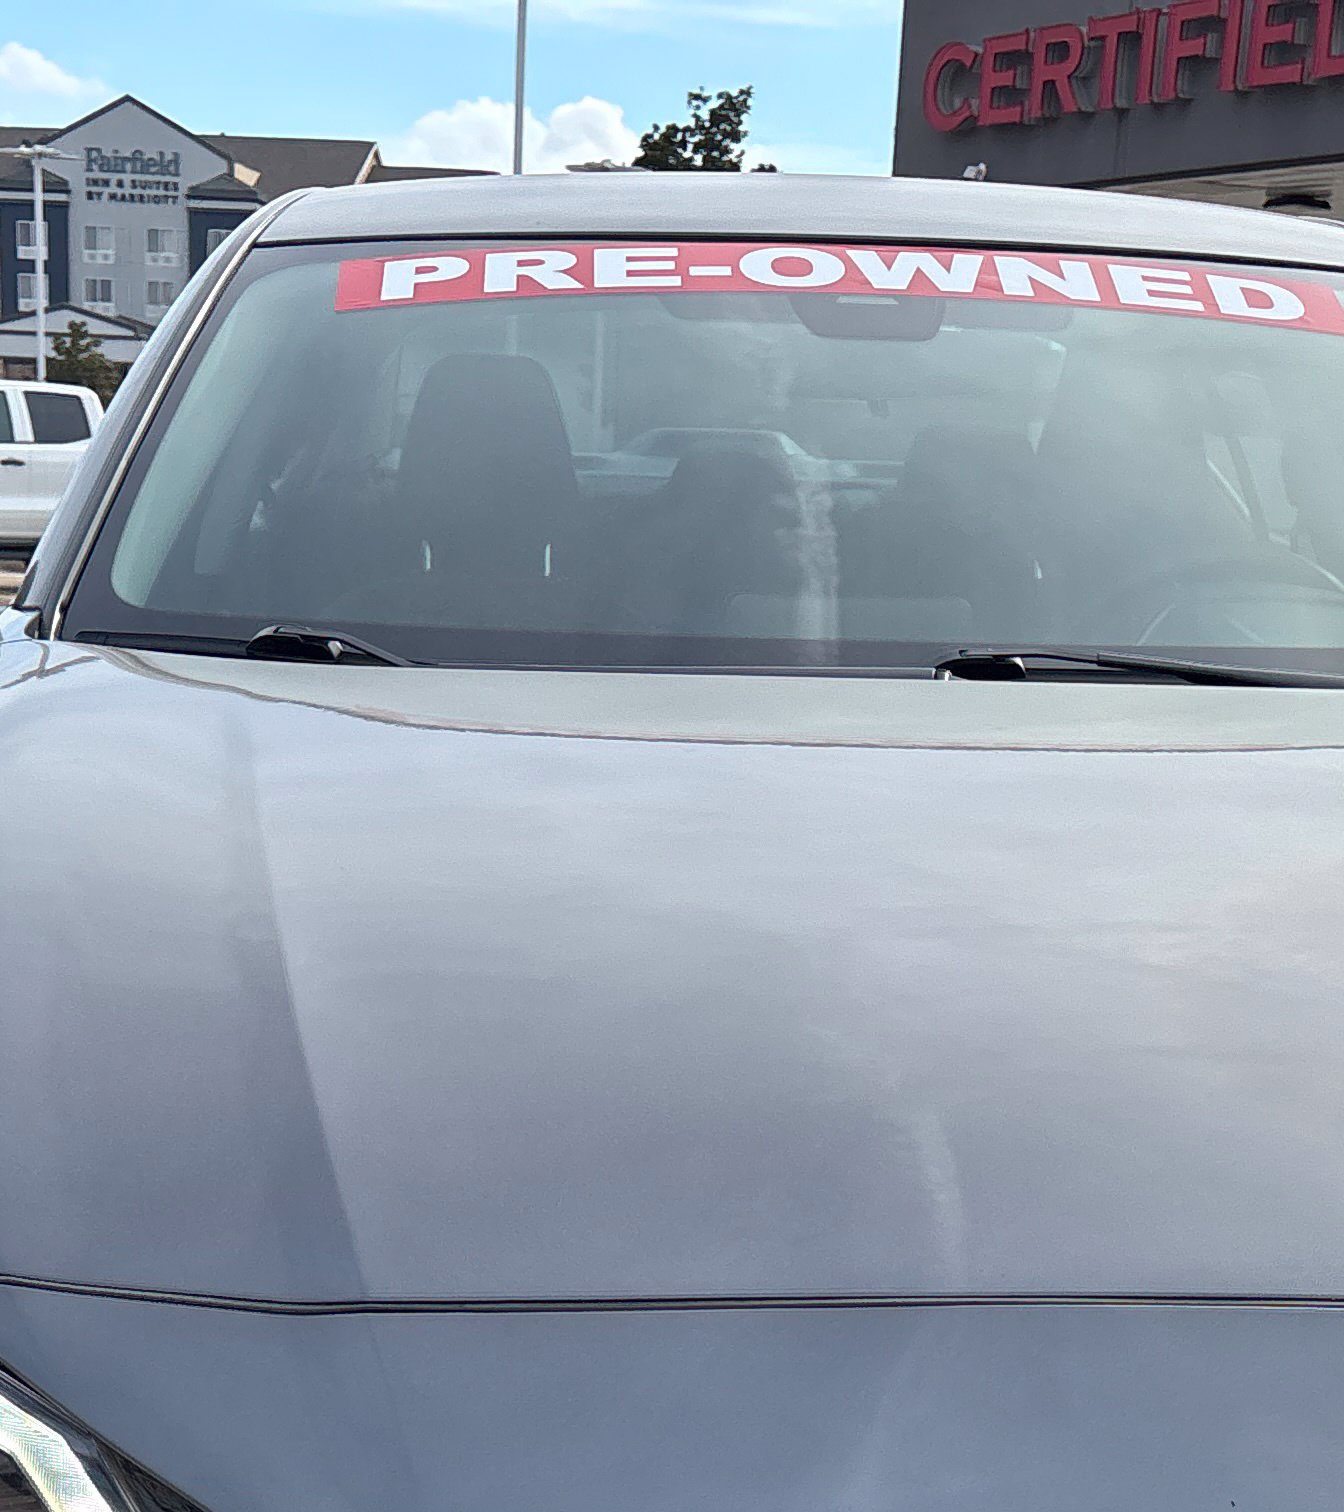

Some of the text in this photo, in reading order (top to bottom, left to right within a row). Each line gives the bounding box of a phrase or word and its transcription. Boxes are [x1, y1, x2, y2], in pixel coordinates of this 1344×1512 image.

[84, 147, 181, 177] Fairfield
[86, 177, 110, 188] INN
[130, 179, 179, 192] SUITES
[86, 190, 179, 205] BY MARRIOTT
[380, 247, 1304, 320] PRE-OWNED
